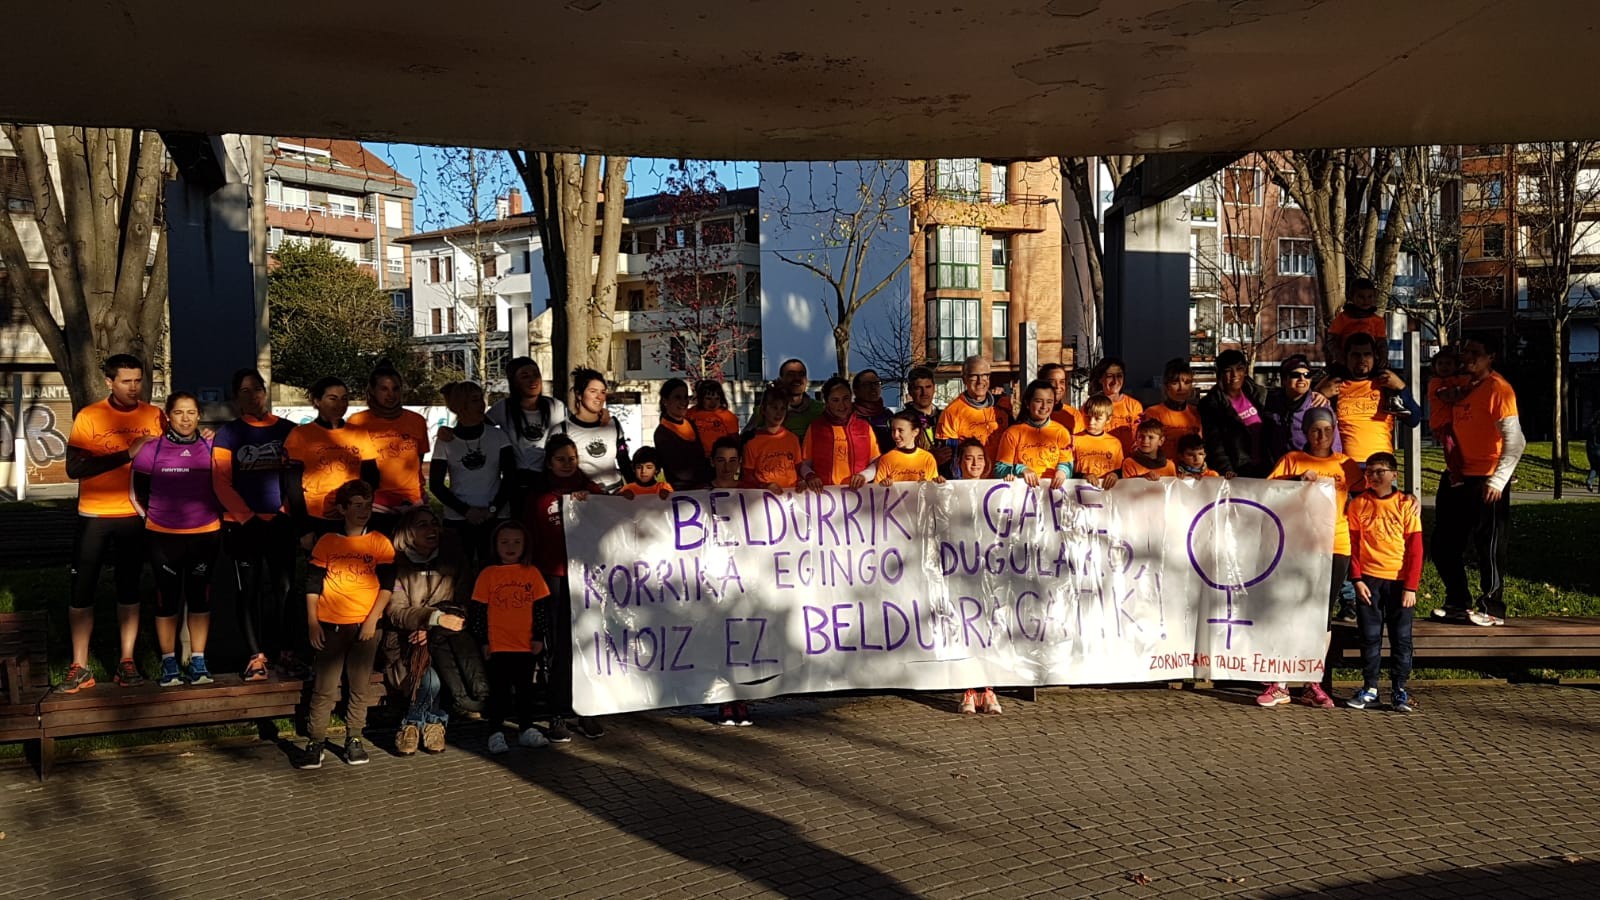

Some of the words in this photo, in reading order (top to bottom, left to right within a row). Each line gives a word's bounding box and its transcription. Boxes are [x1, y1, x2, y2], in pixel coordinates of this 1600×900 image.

[671, 487, 913, 551] BELDURRIK
[583, 555, 745, 610] KORRIKA
[773, 546, 906, 590] EGINGO
[593, 625, 695, 677] INOIZ
[725, 617, 779, 668] EZ
[1214, 654, 1248, 673] TALDE
[1252, 652, 1326, 675] FEMINISTA
